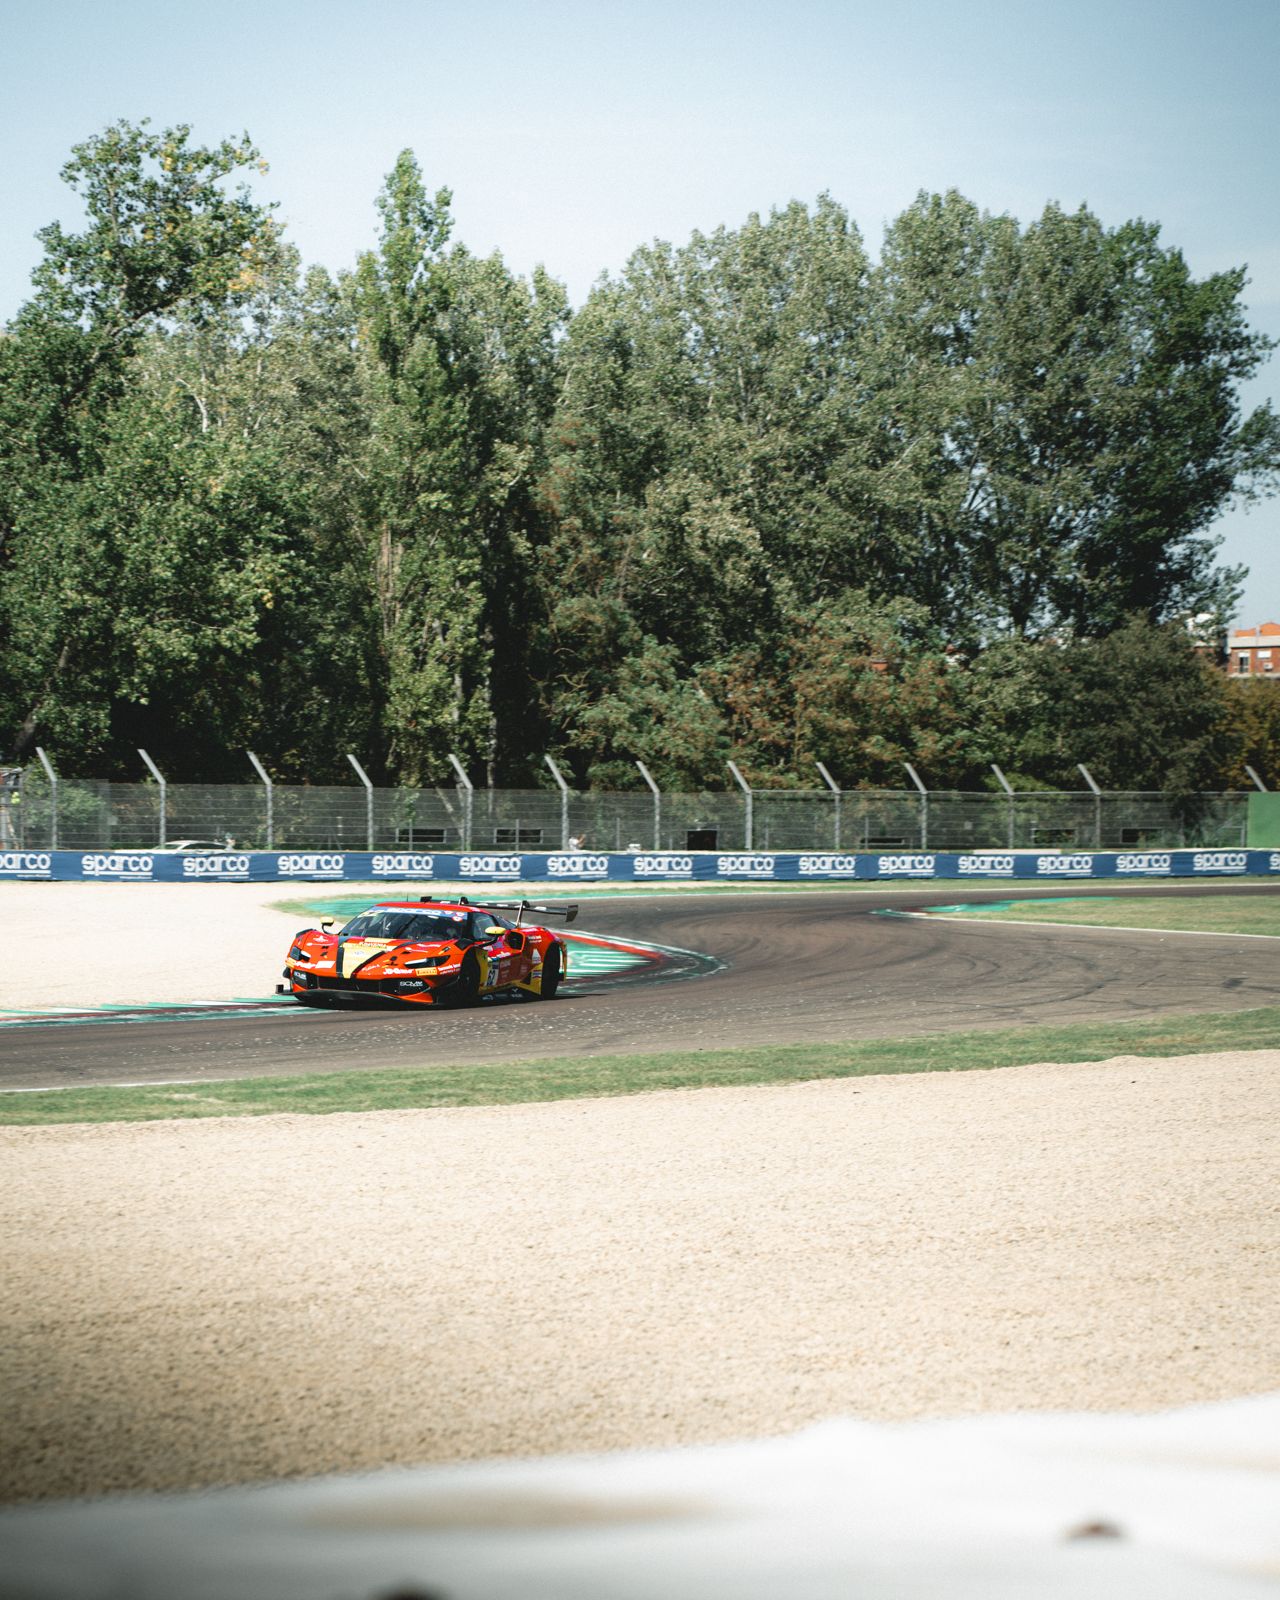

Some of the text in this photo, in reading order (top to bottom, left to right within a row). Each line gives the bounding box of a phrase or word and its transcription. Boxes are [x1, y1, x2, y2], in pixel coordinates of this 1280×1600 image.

[81, 855, 154, 876] sparco
[183, 856, 251, 877] sparco
[278, 855, 345, 875] sparco
[372, 855, 434, 875] sparco
[459, 857, 522, 876] sparco
[547, 857, 609, 876] sparco
[634, 857, 693, 875] sparco
[717, 857, 774, 875] sparco
[799, 857, 856, 875] sparco
[878, 856, 935, 874] sparco
[958, 856, 1014, 874] sparco
[1037, 856, 1093, 874] sparco
[1116, 855, 1171, 873] sparco
[1193, 854, 1246, 872] sparco
